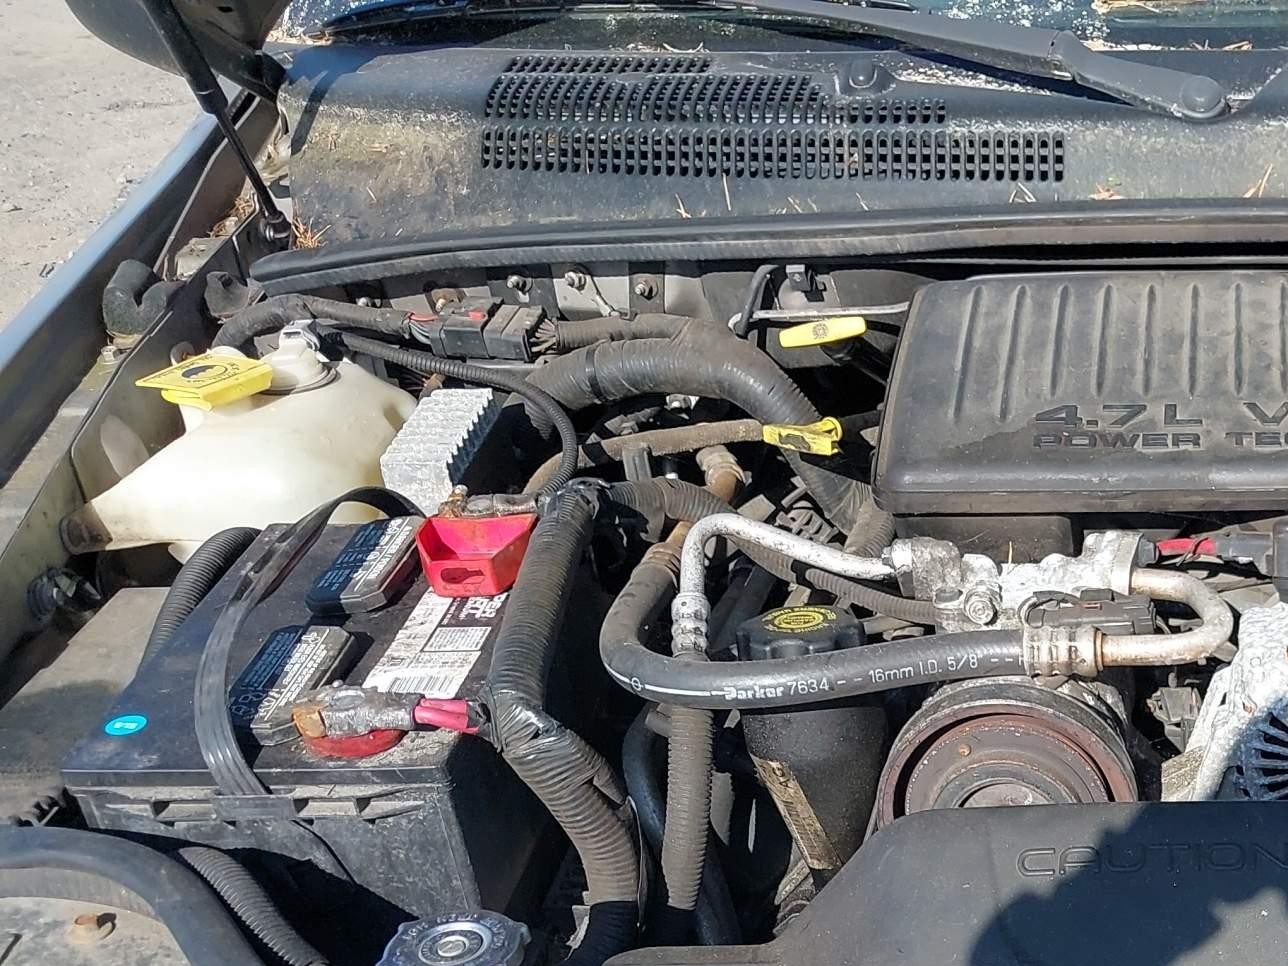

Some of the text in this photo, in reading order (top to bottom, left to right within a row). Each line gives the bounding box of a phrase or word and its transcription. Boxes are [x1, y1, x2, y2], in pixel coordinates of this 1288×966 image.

[1032, 432, 1204, 450] POWER
[723, 685, 785, 700] Parker
[787, 680, 830, 695] 7634
[868, 666, 914, 683] 16mm
[920, 660, 942, 675] I.D.
